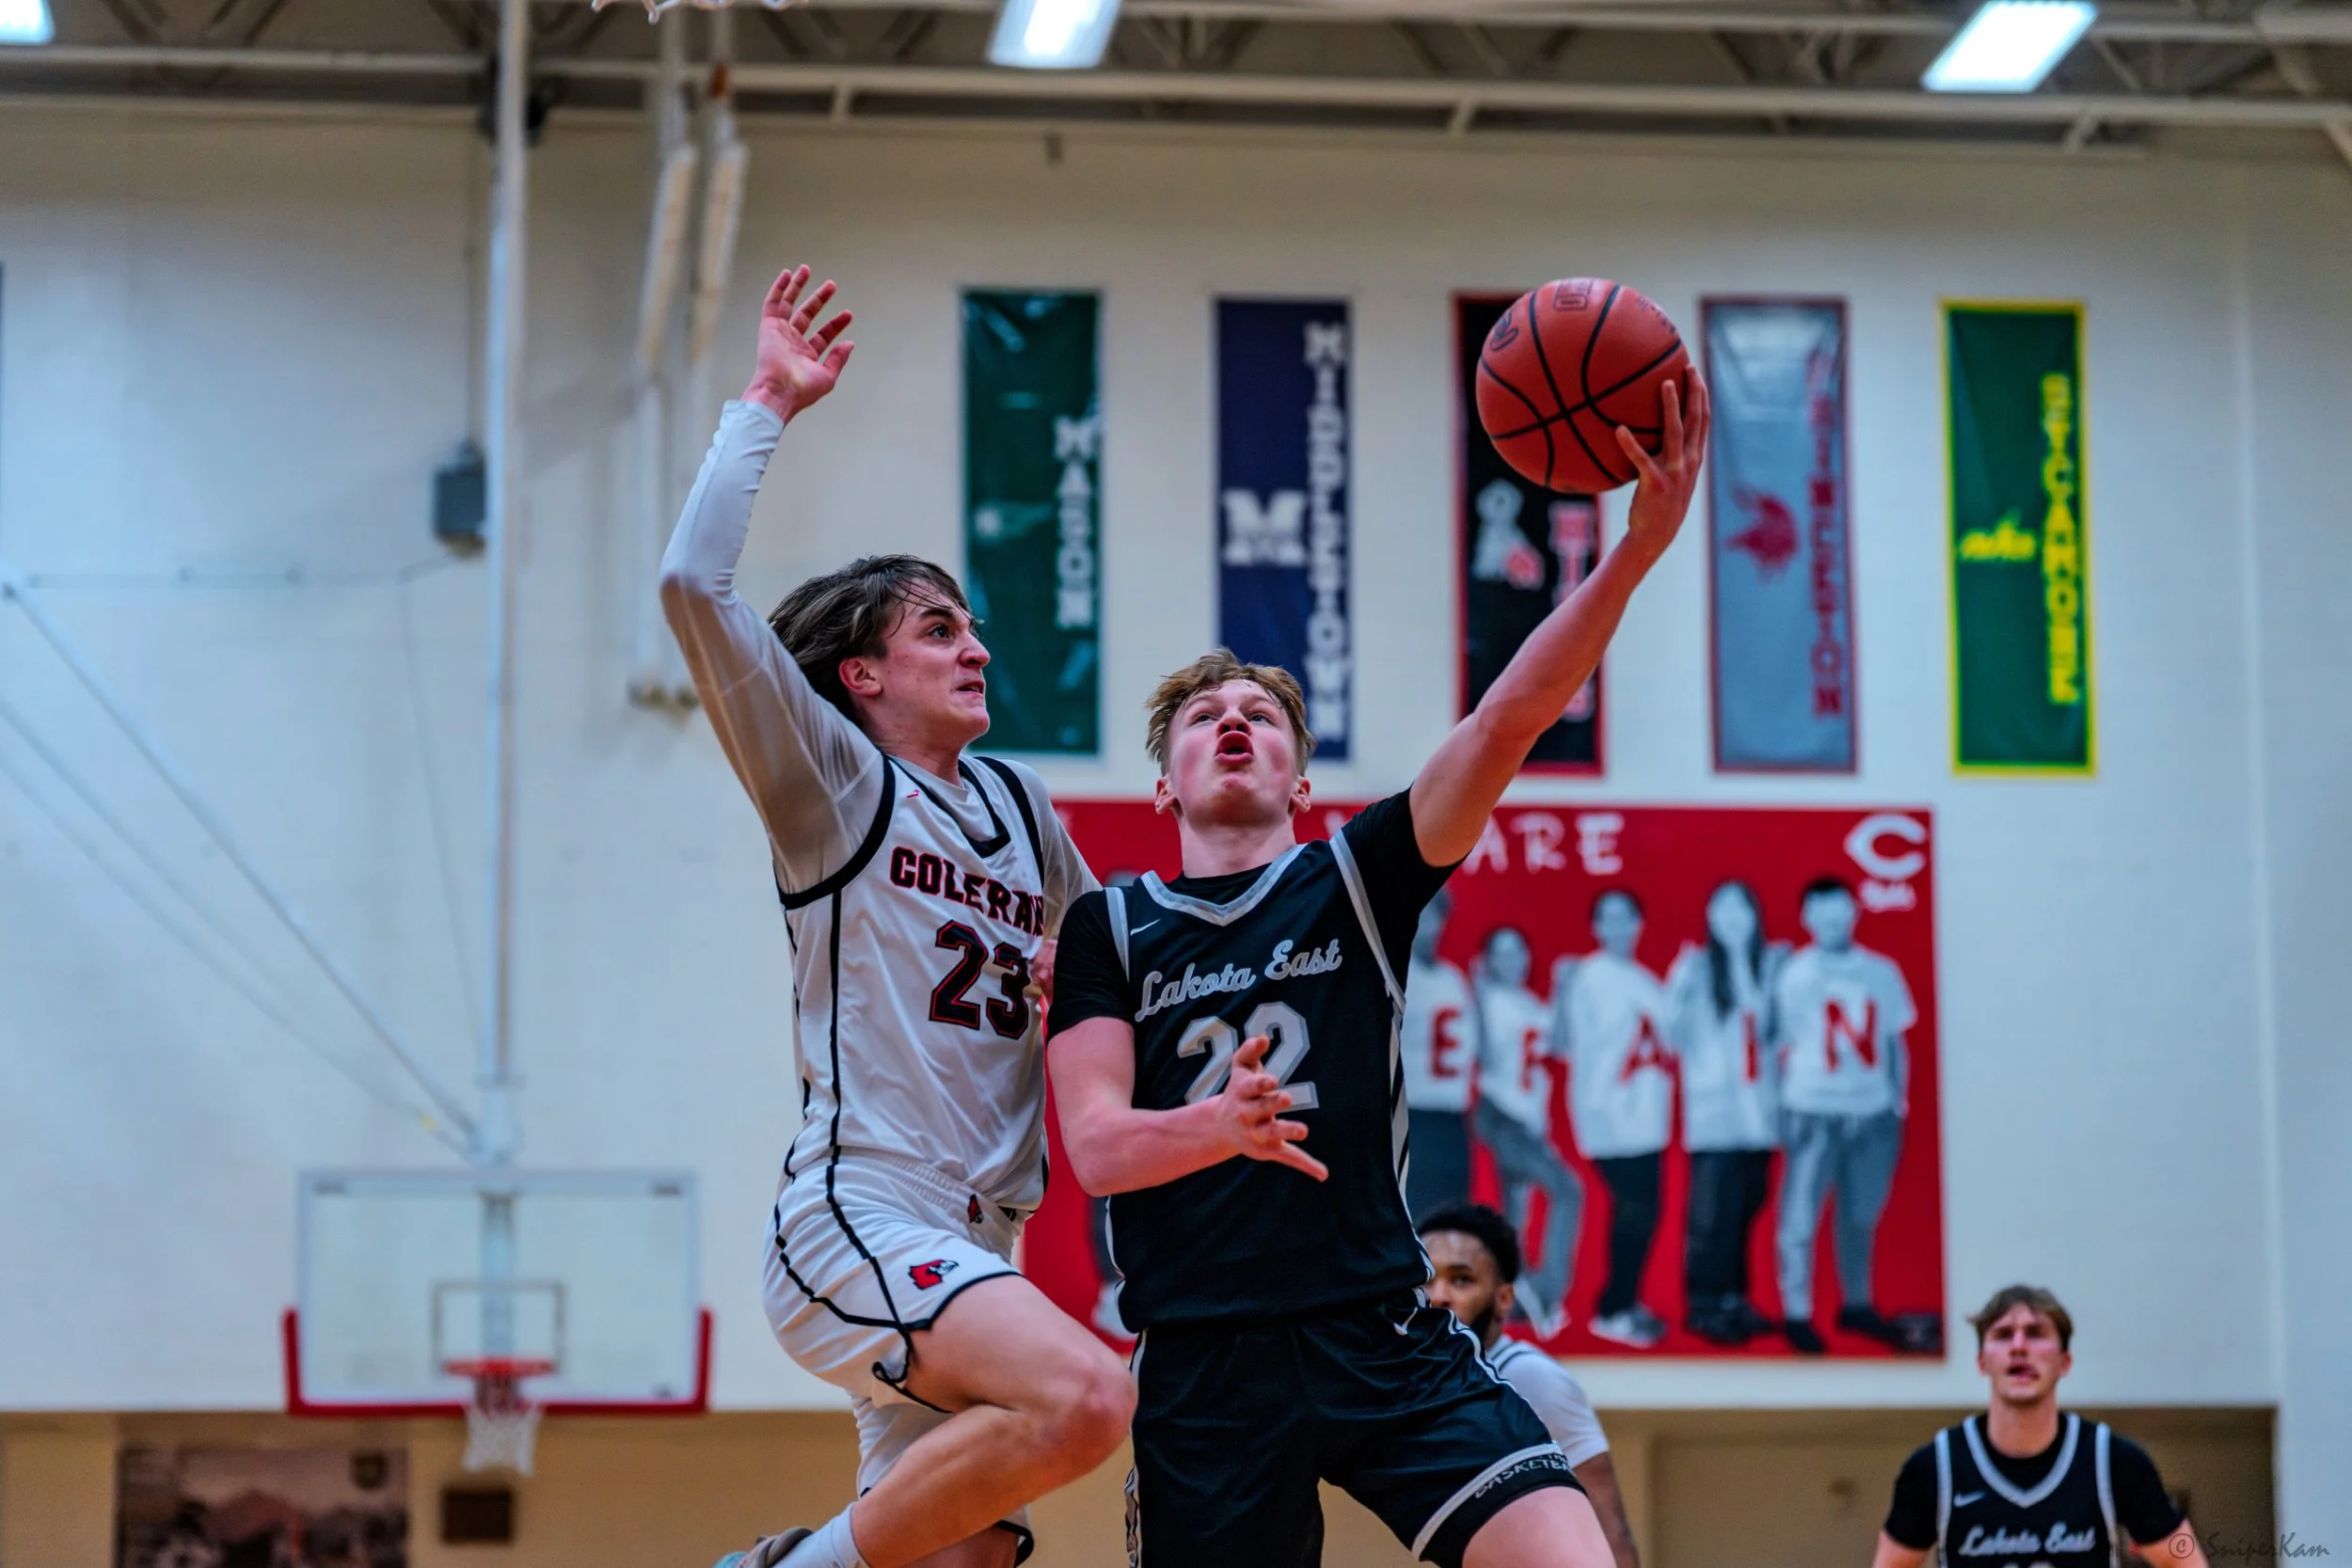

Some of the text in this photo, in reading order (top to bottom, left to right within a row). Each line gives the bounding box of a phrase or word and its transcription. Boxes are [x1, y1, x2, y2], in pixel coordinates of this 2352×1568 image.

[1053, 415, 1094, 628] MASON
[1223, 488, 1306, 565] M
[1304, 321, 1347, 740] MIDDLETOWN
[2040, 372, 2080, 705] SYCAMORE
[1462, 811, 1626, 876] ARE
[1842, 814, 1927, 880] C
[929, 919, 1031, 1040] 23
[1135, 939, 1343, 1022] Lakota East
[1178, 1001, 1320, 1114] 22
[1959, 1520, 2097, 1557] Lakota East
